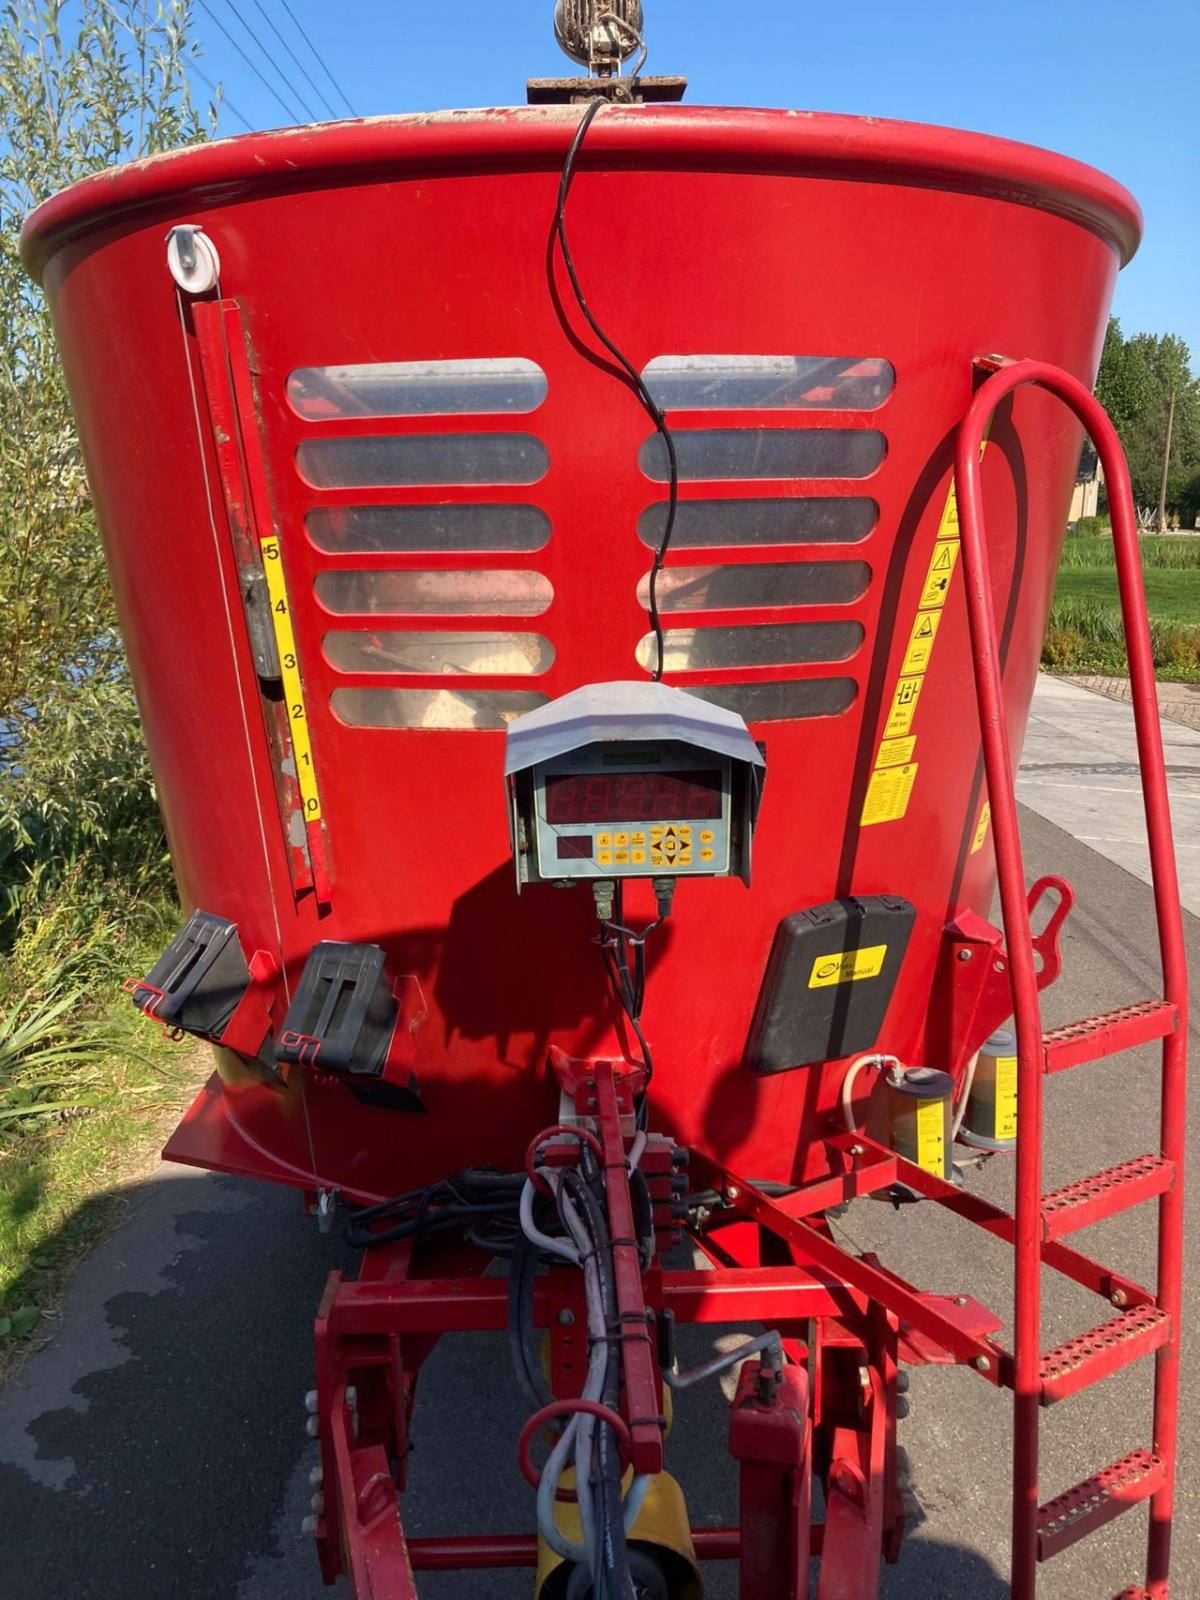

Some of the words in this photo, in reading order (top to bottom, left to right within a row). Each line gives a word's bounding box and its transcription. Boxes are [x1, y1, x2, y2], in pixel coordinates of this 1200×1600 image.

[266, 544, 279, 560] 5
[275, 600, 287, 614] 4
[284, 653, 296, 669] 3
[292, 704, 304, 719] 2
[301, 752, 310, 766] 1
[307, 798, 318, 811] 0
[846, 966, 875, 977] Manual
